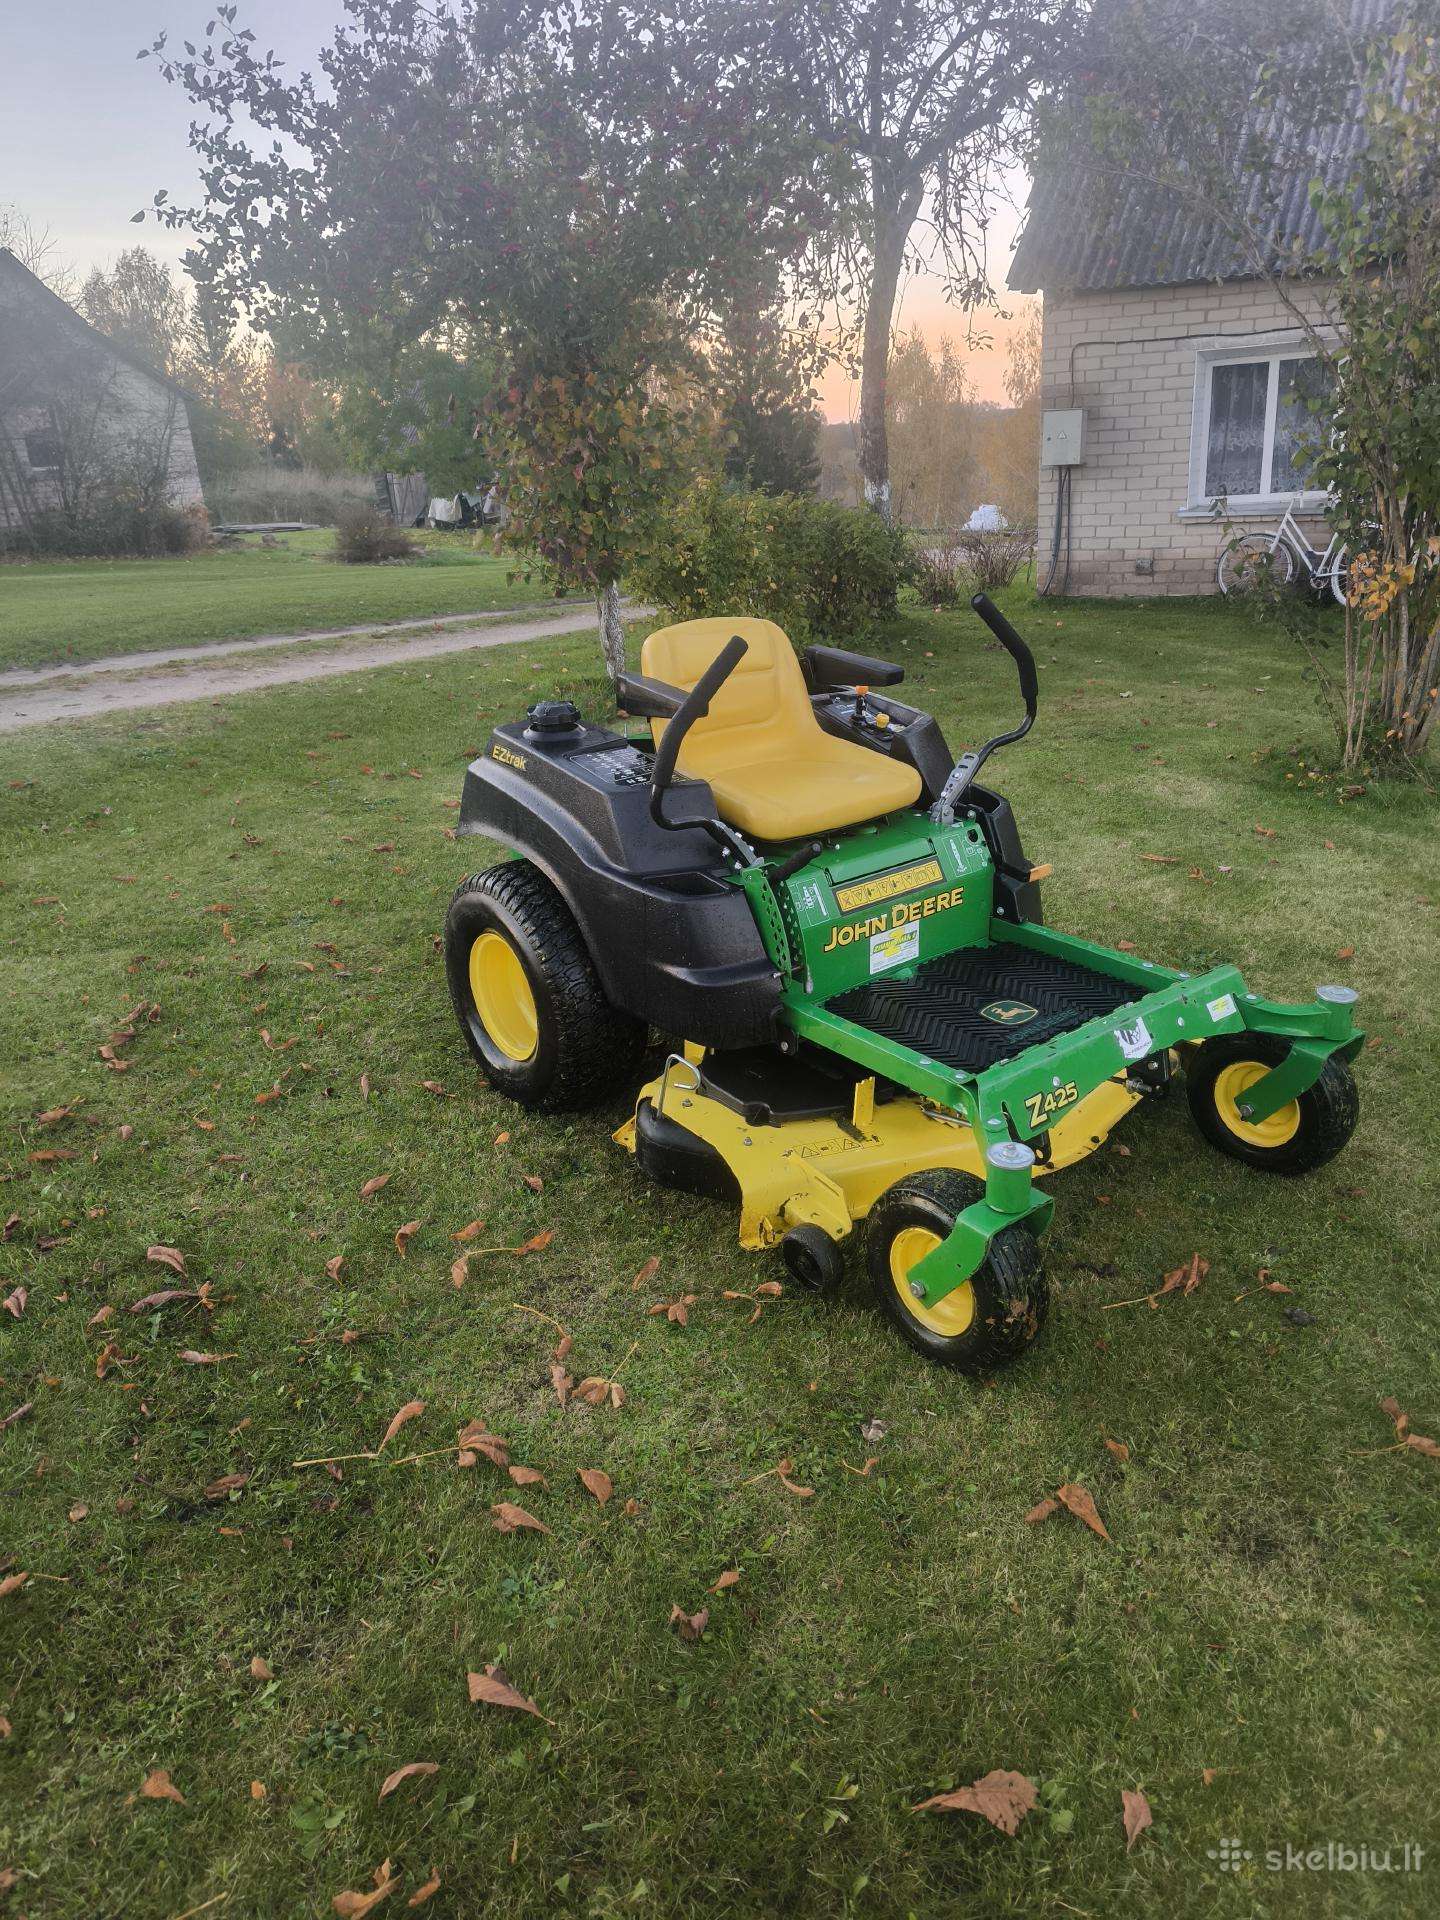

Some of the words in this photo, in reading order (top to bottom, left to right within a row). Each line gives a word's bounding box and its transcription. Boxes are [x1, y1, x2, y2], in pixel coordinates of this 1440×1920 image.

[492, 744, 527, 771] EZtrak
[824, 913, 888, 952] JOHN
[891, 886, 964, 929] DEERE
[1024, 1081, 1078, 1128] Z425
